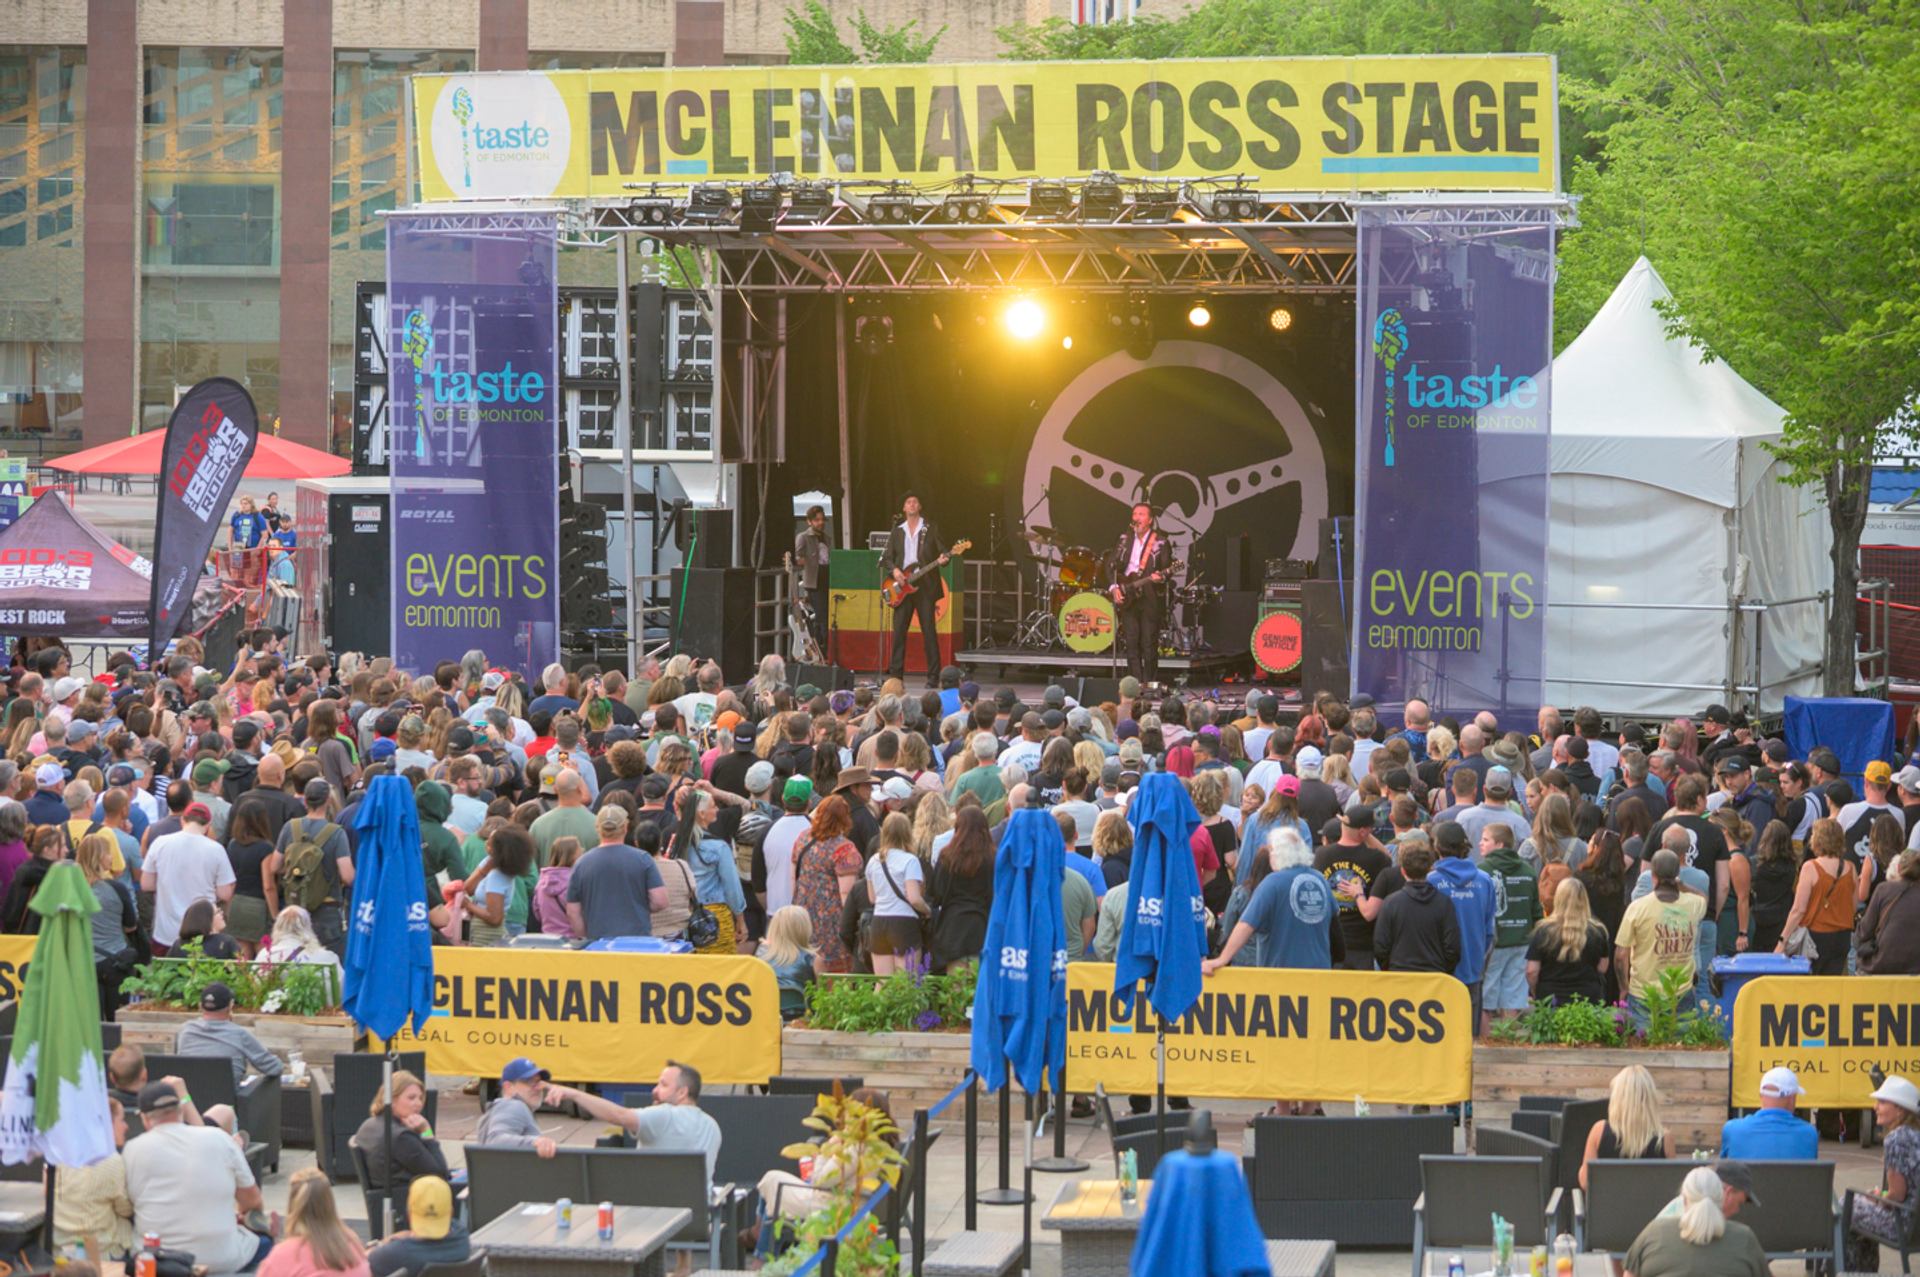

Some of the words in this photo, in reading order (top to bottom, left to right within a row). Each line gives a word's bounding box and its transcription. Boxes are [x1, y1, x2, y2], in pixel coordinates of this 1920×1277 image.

[1076, 80, 1301, 171] ROSS
[1322, 80, 1540, 153] STAGE
[473, 120, 549, 149] taste
[477, 153, 490, 163] OF
[493, 151, 550, 162] EDMONTON
[429, 361, 545, 403] taste
[1403, 363, 1539, 409] taste
[433, 409, 453, 422] OF
[460, 409, 544, 422] EDMONTON
[1407, 415, 1430, 428] OF
[1437, 415, 1537, 429] EDMONTON
[201, 438, 244, 513] ROCKS
[400, 510, 455, 519] ROYAL
[0, 609, 25, 624] EST
[28, 610, 66, 624] ROCK
[1262, 634, 1298, 643] GENUINE
[1263, 641, 1297, 650] ARTICLE
[1654, 938, 1694, 955] CRUZ
[640, 982, 752, 1026] ROSS
[1330, 997, 1445, 1042] ROSS
[394, 1027, 455, 1043] EGAL
[467, 1030, 569, 1048] COUNSEL
[1069, 1045, 1137, 1060] LEGAL
[1760, 1060, 1830, 1073] LEGAL
